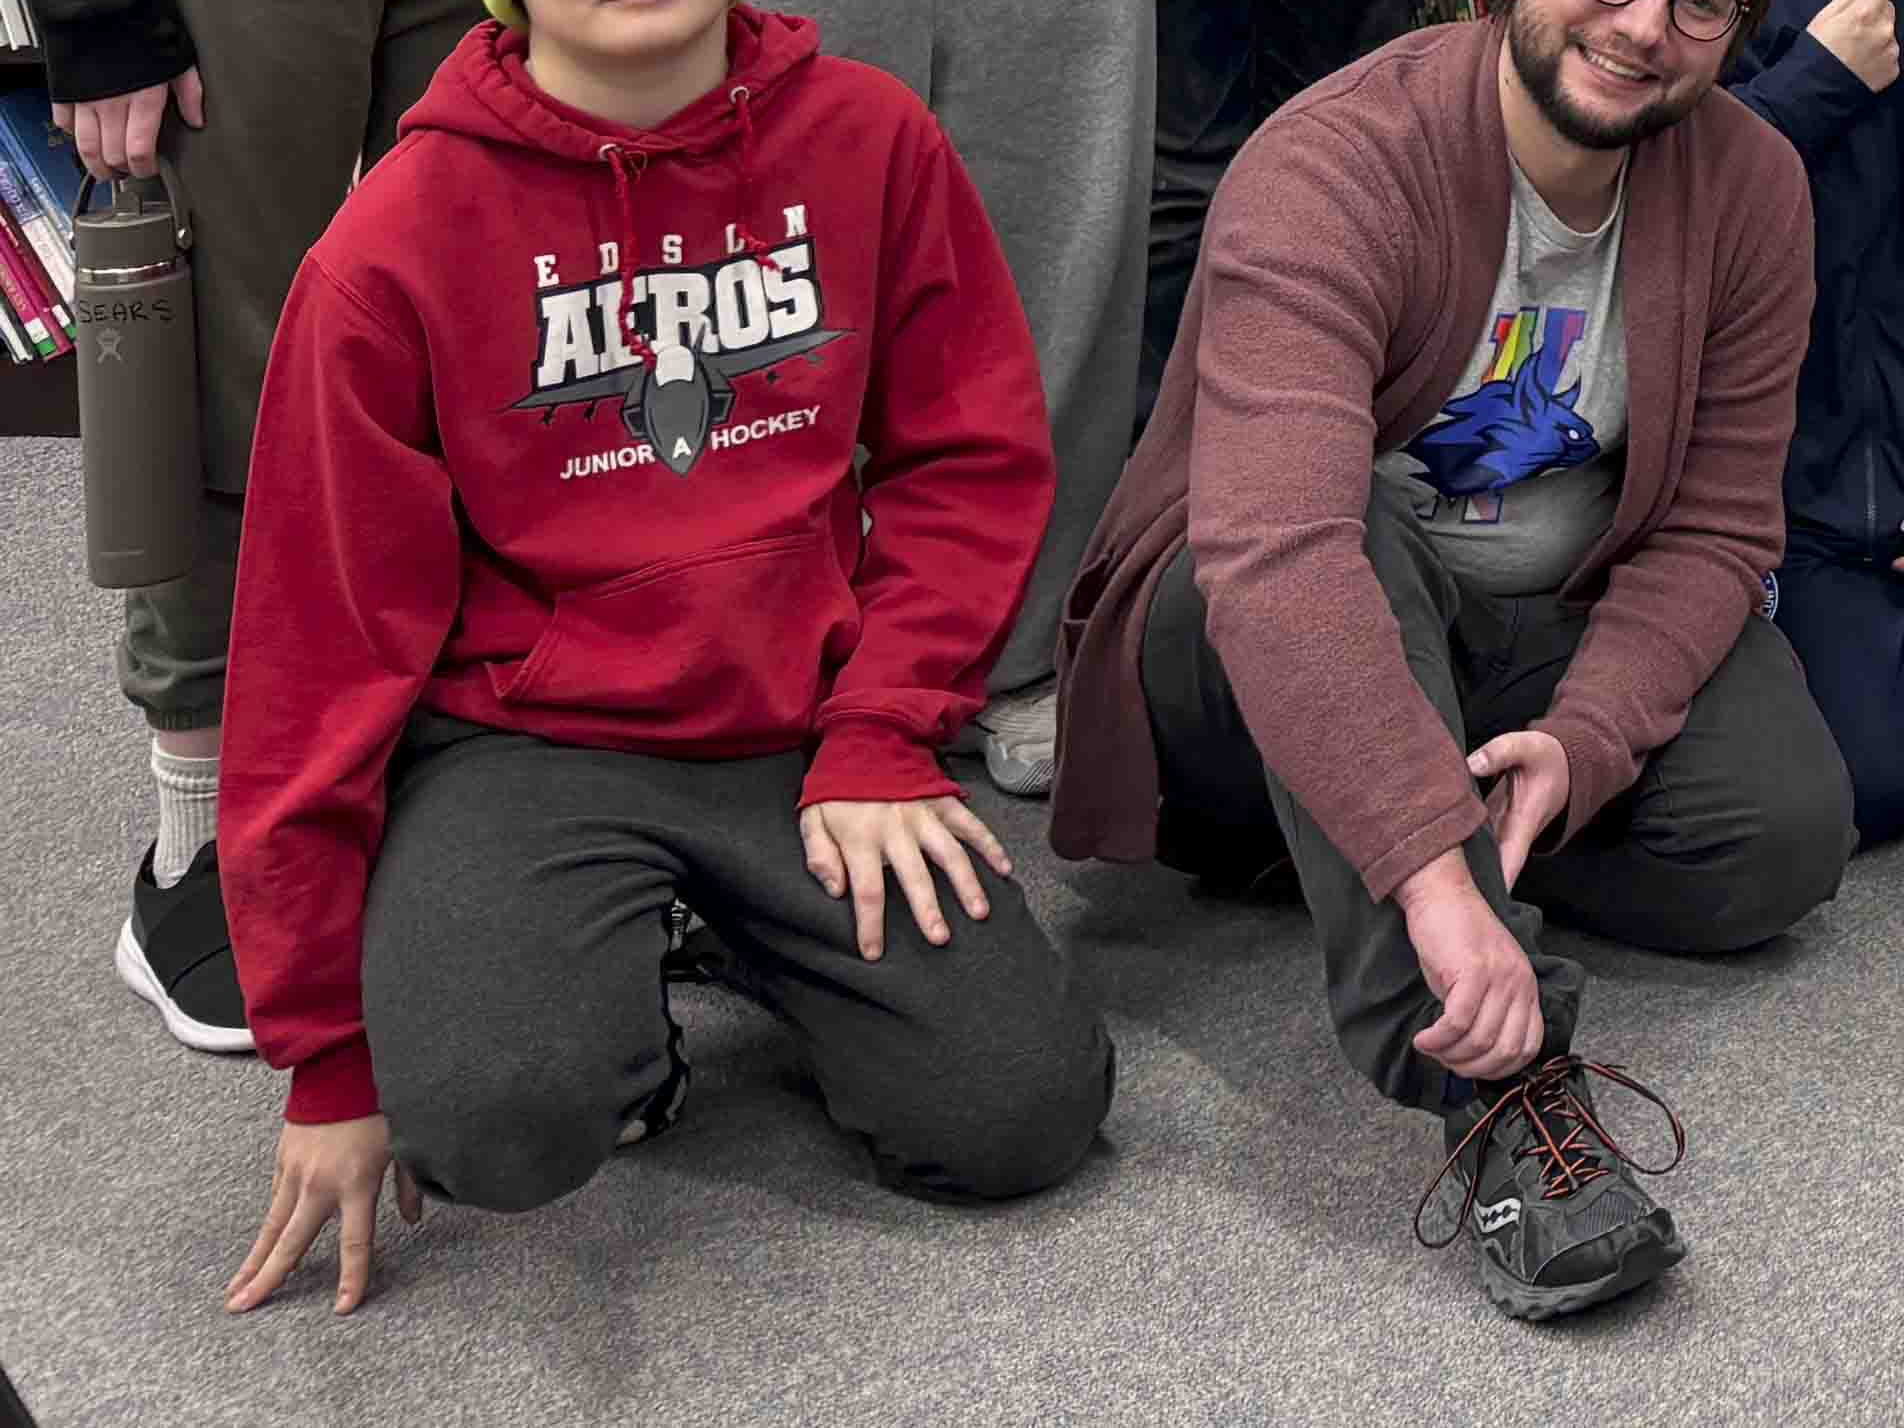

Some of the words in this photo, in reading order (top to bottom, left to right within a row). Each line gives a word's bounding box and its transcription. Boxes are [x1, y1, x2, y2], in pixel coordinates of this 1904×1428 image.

[536, 242, 819, 388] AEROS
[560, 444, 655, 480] JUNIOR
[672, 437, 692, 459] A
[711, 406, 822, 451] HOCKEY
